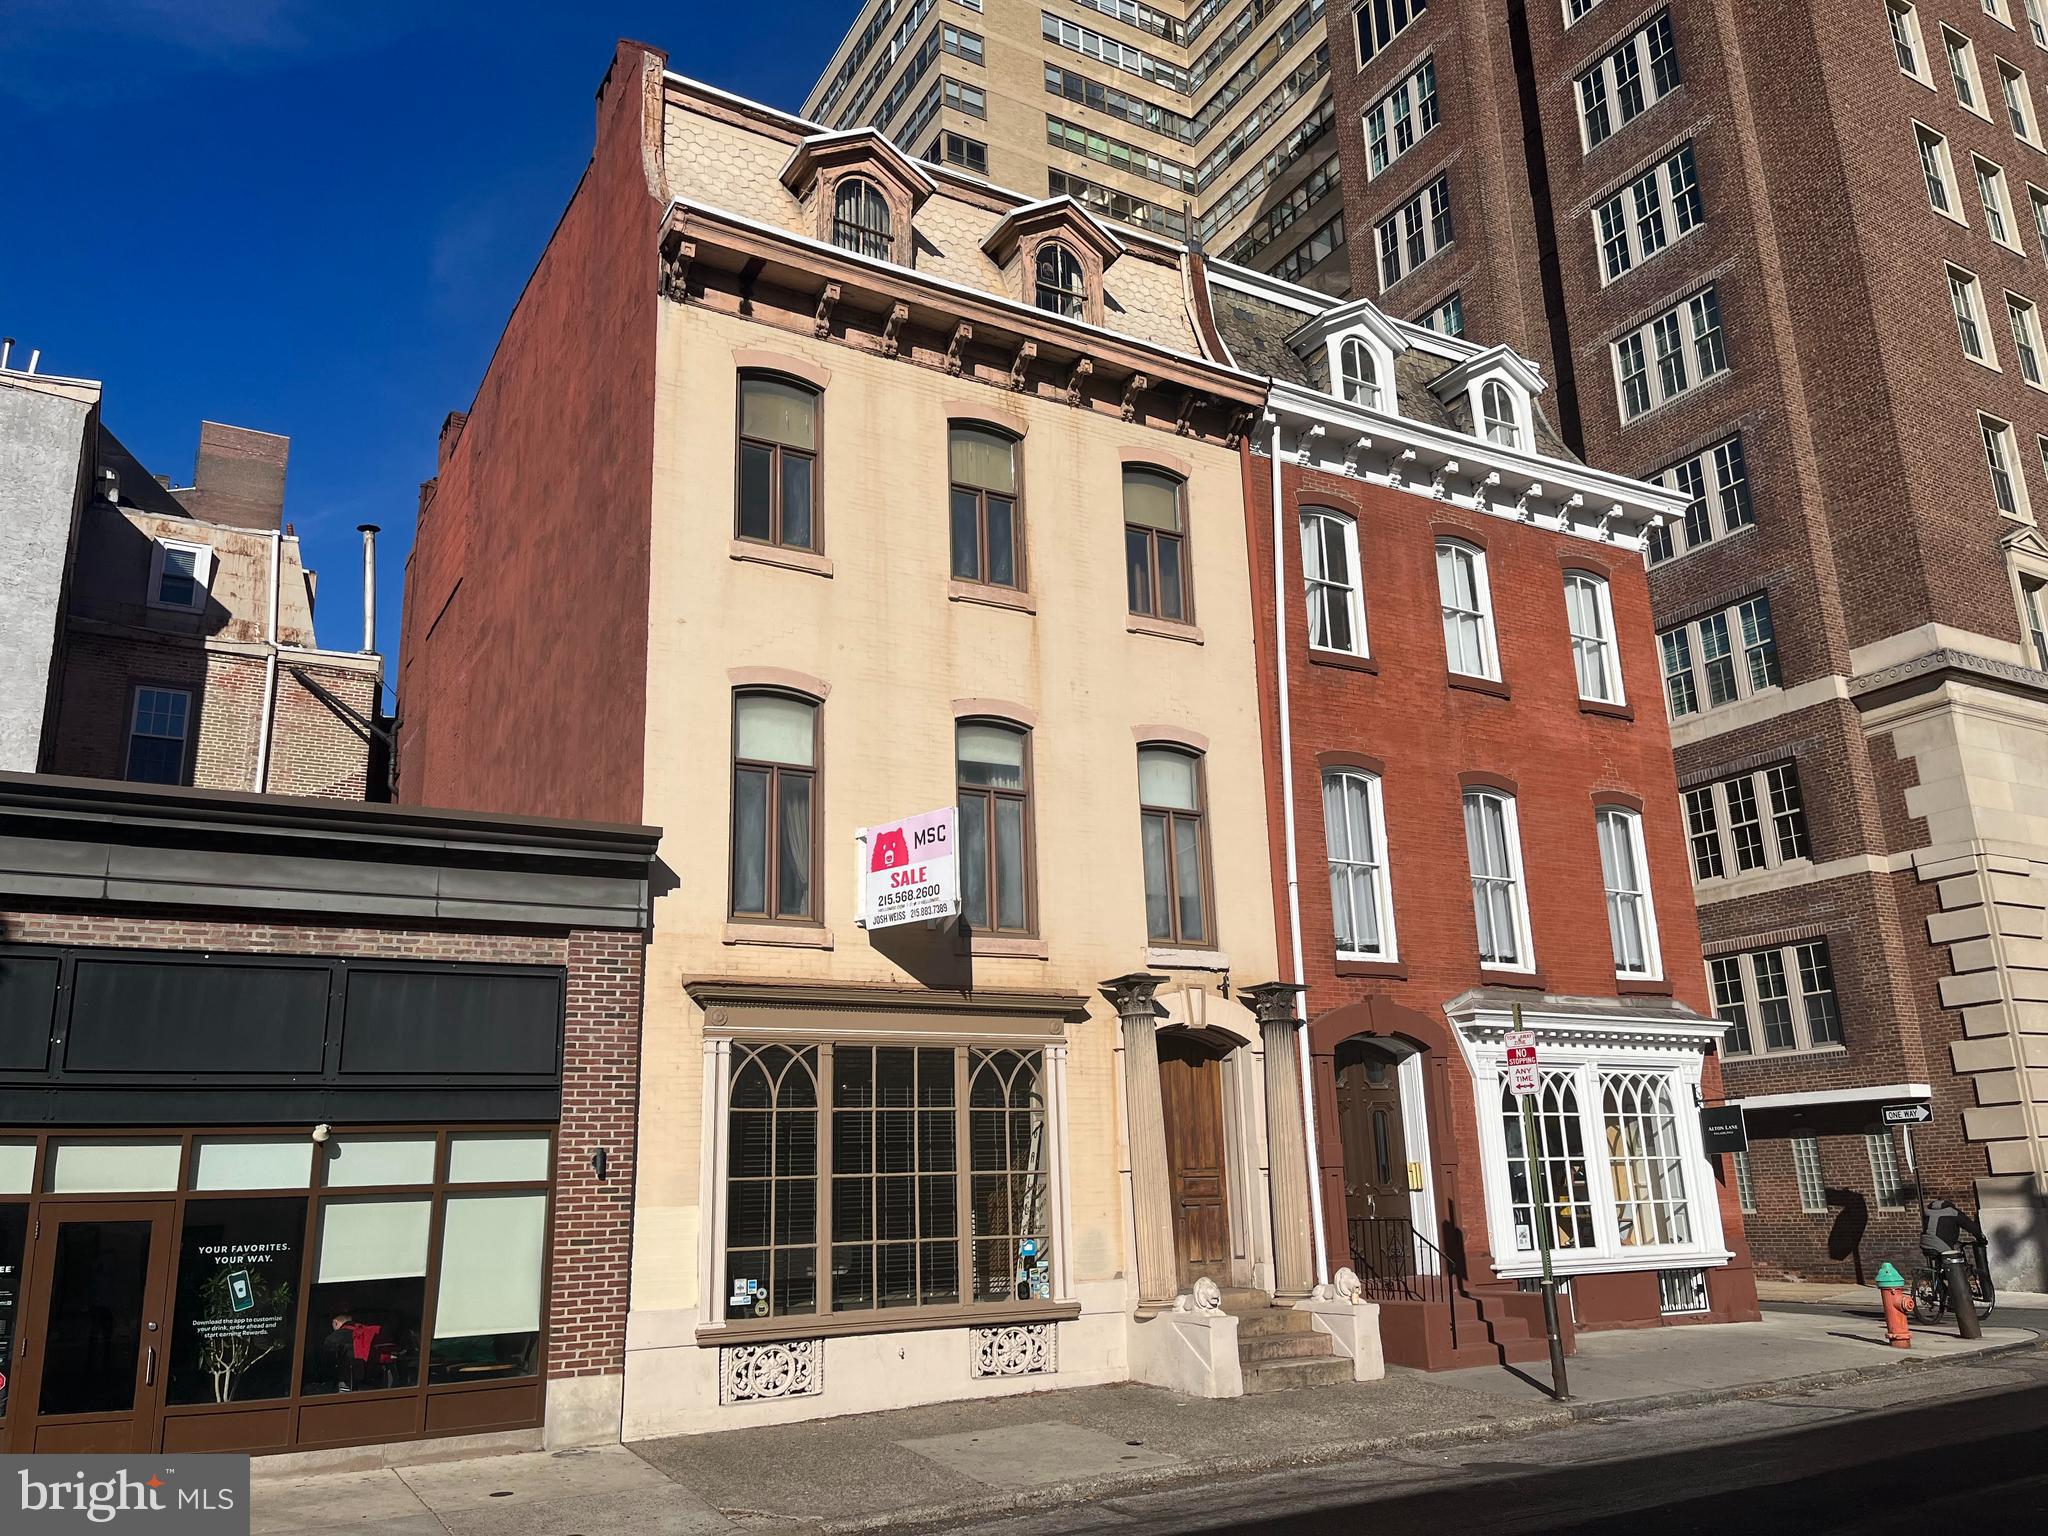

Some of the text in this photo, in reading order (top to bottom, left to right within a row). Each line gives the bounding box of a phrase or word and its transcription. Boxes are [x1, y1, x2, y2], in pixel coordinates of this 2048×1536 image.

[914, 824, 946, 849] MSC
[891, 866, 927, 888] SALE
[878, 884, 940, 906] 215.568.2600
[873, 913, 888, 925] JOSH
[889, 911, 906, 922] WEISS
[1516, 1049, 1526, 1058] NO
[1509, 1057, 1535, 1065] STOPPING
[199, 1243, 290, 1254] YOUR FAVORITES.
[247, 1255, 273, 1263] WAY.
